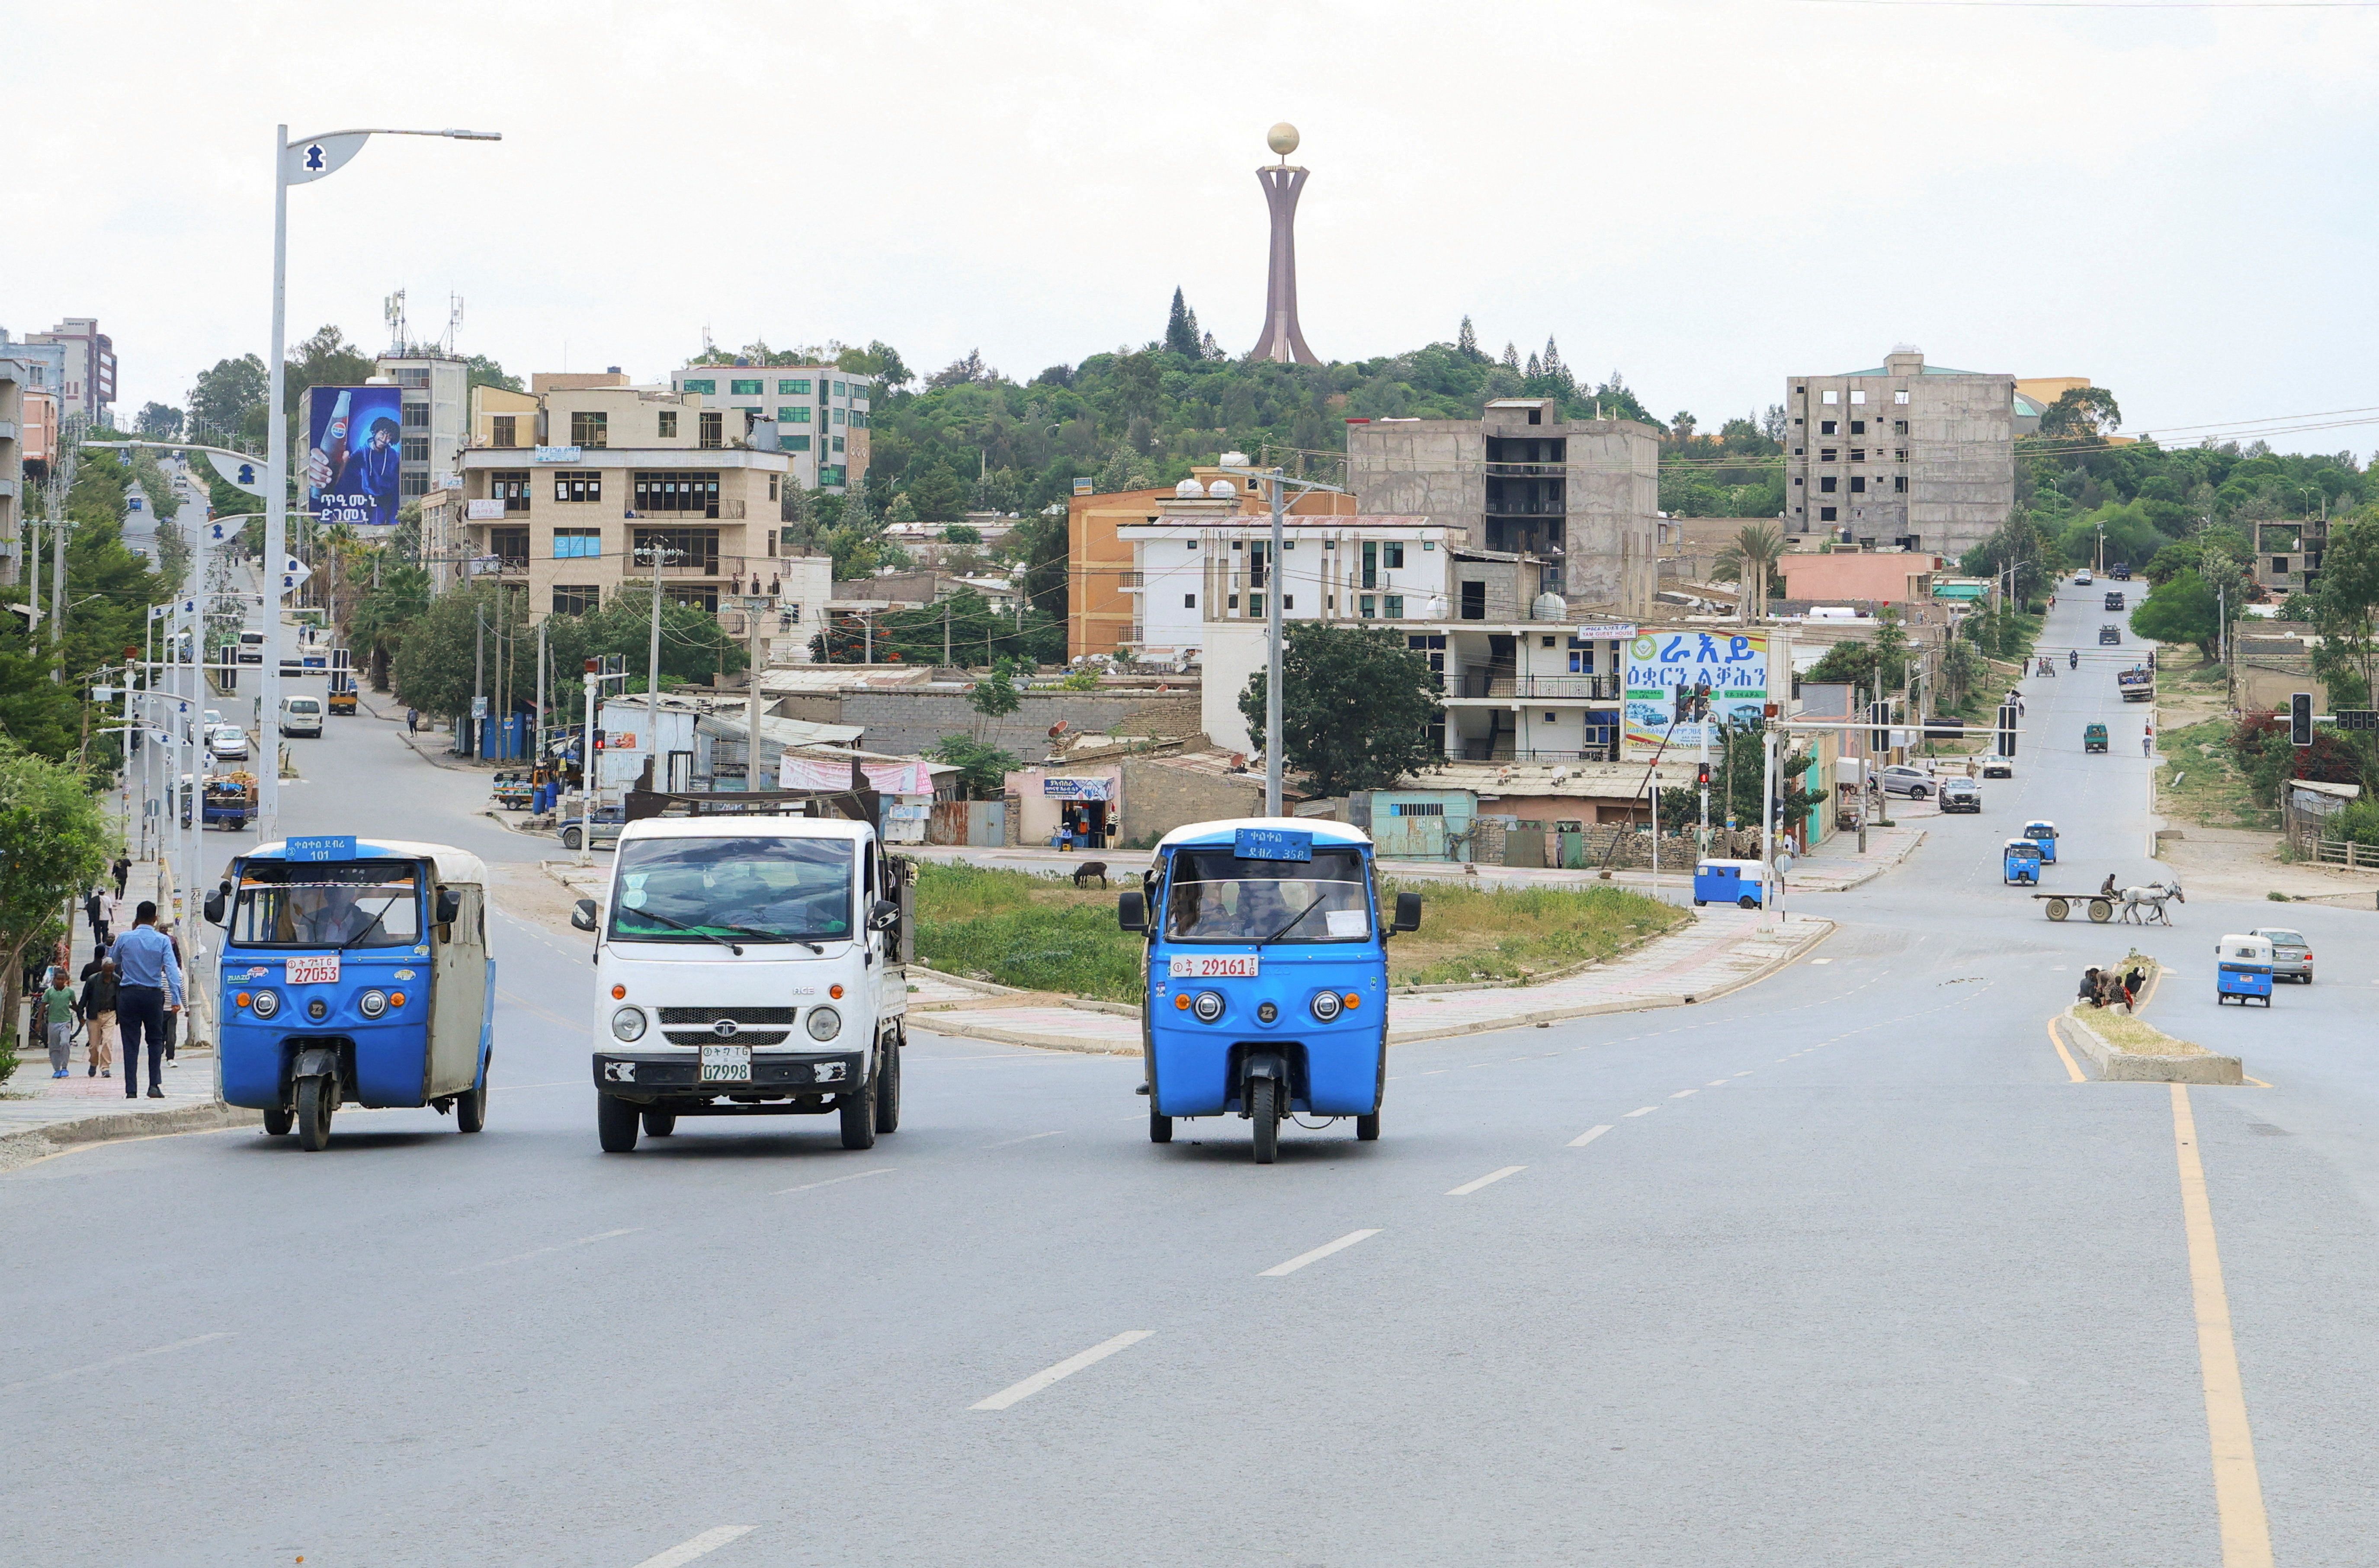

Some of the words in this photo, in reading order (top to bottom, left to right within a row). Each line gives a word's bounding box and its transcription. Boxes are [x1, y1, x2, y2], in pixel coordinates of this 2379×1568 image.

[321, 494, 377, 507] ጥዒሙኒ
[1660, 633, 1754, 664] ራእይ
[1237, 830, 1244, 839] 3
[311, 850, 329, 860] 101
[1282, 849, 1304, 860] 358
[1202, 959, 1245, 975] 29161
[295, 967, 337, 982] 27053
[704, 1065, 747, 1079] 07998
